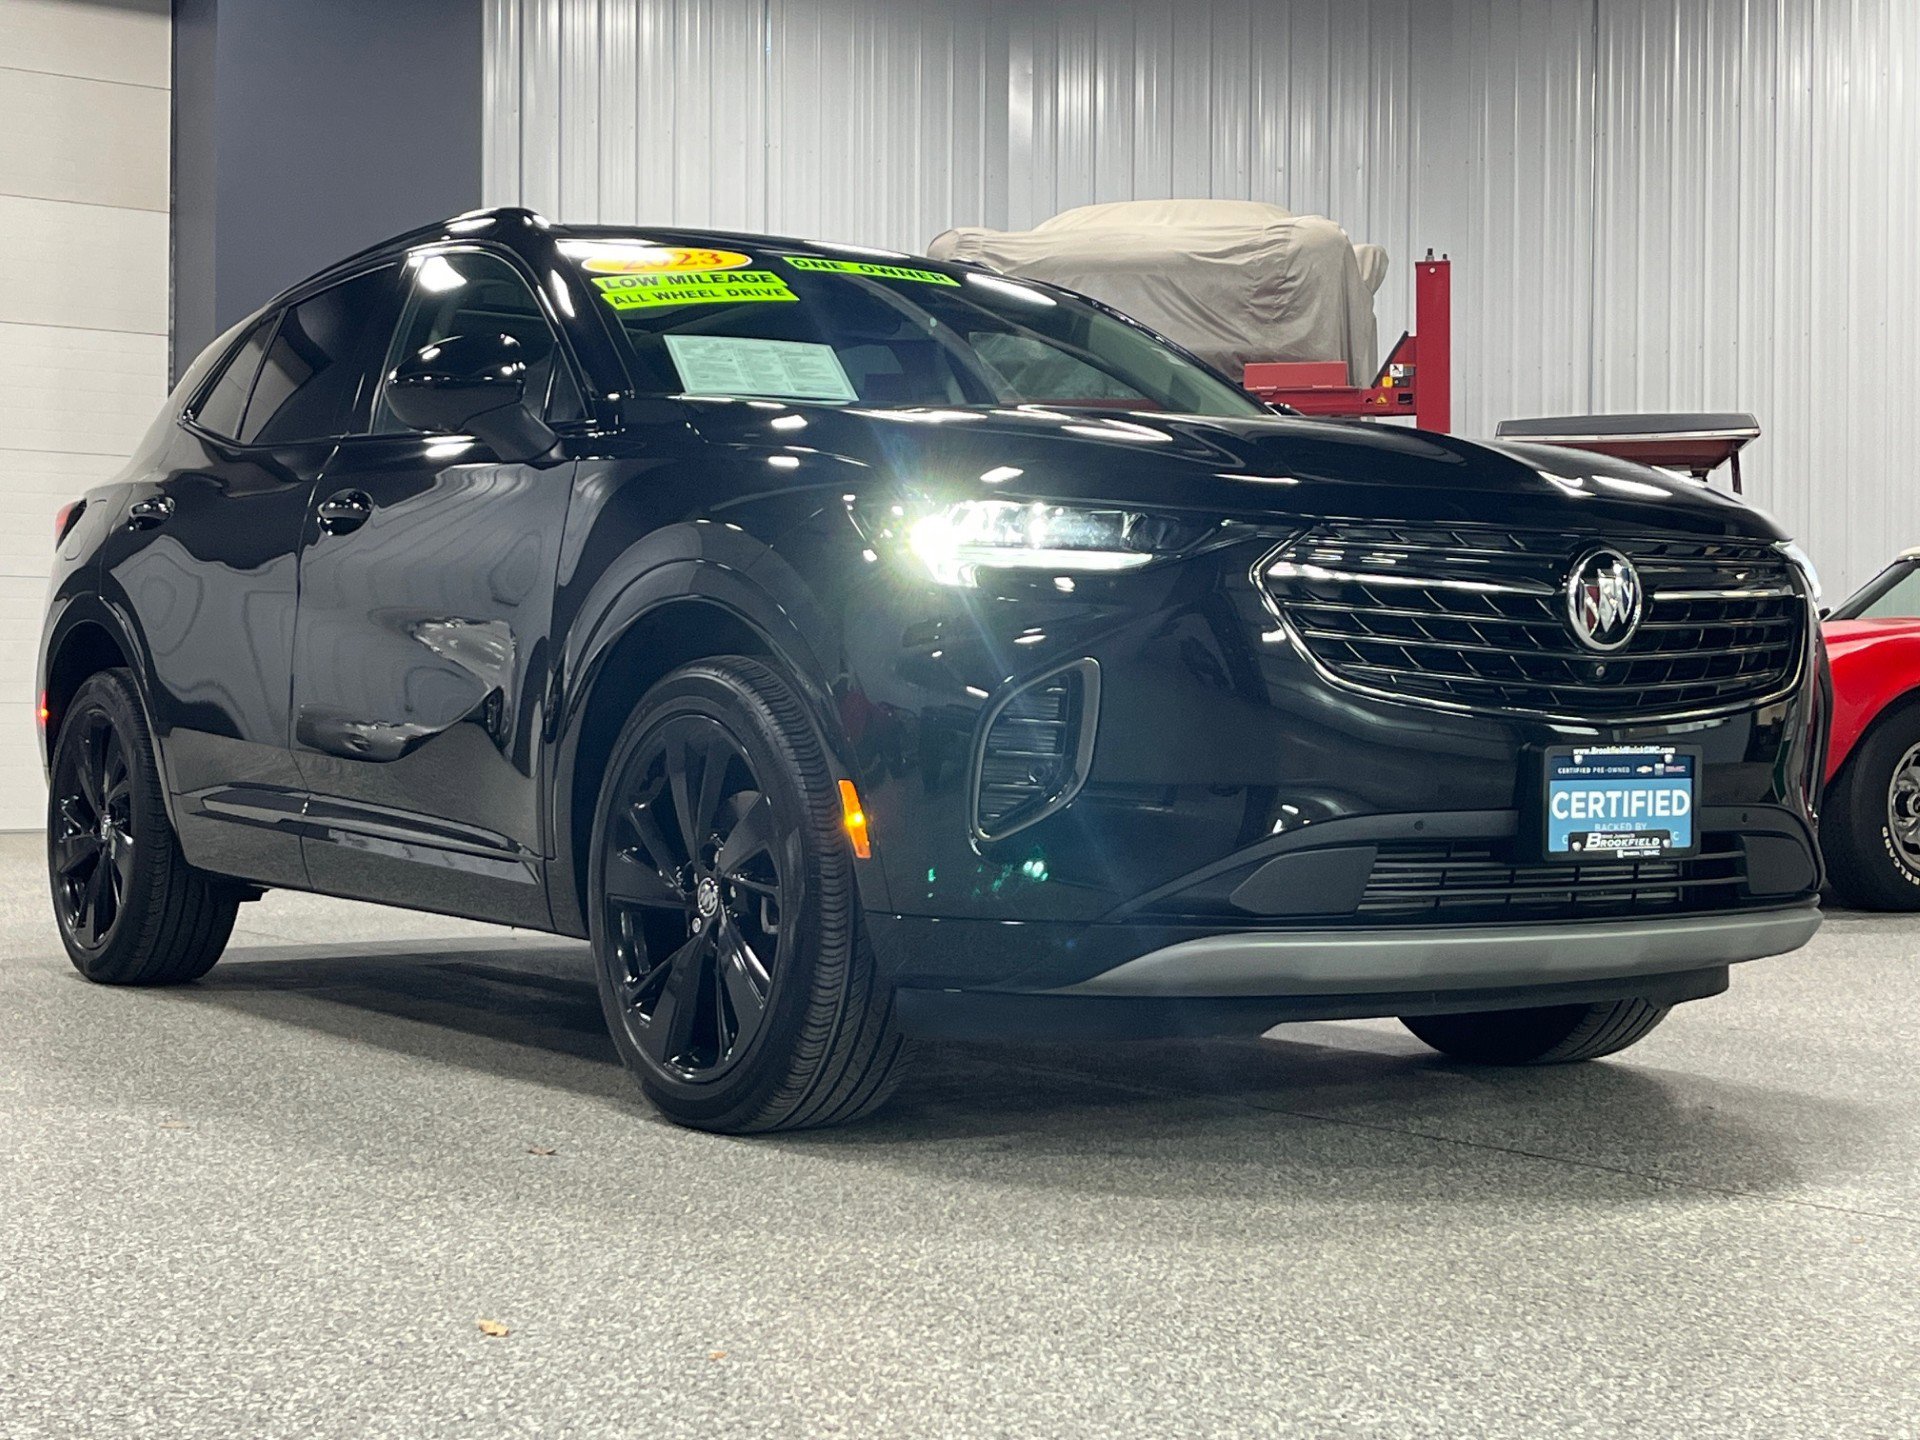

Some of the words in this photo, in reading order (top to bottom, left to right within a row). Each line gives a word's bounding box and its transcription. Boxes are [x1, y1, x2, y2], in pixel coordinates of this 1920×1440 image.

[793, 259, 843, 269] ONE
[859, 265, 947, 281] OWNER
[604, 275, 658, 289] LOW
[666, 273, 777, 286] MILEAGE
[613, 293, 650, 305] ALL
[652, 288, 720, 300] WHEEL
[728, 287, 788, 297] DRIVE
[1551, 789, 1691, 820] CERTIFIED
[1594, 822, 1632, 831] BACKED
[1635, 822, 1647, 830] BY
